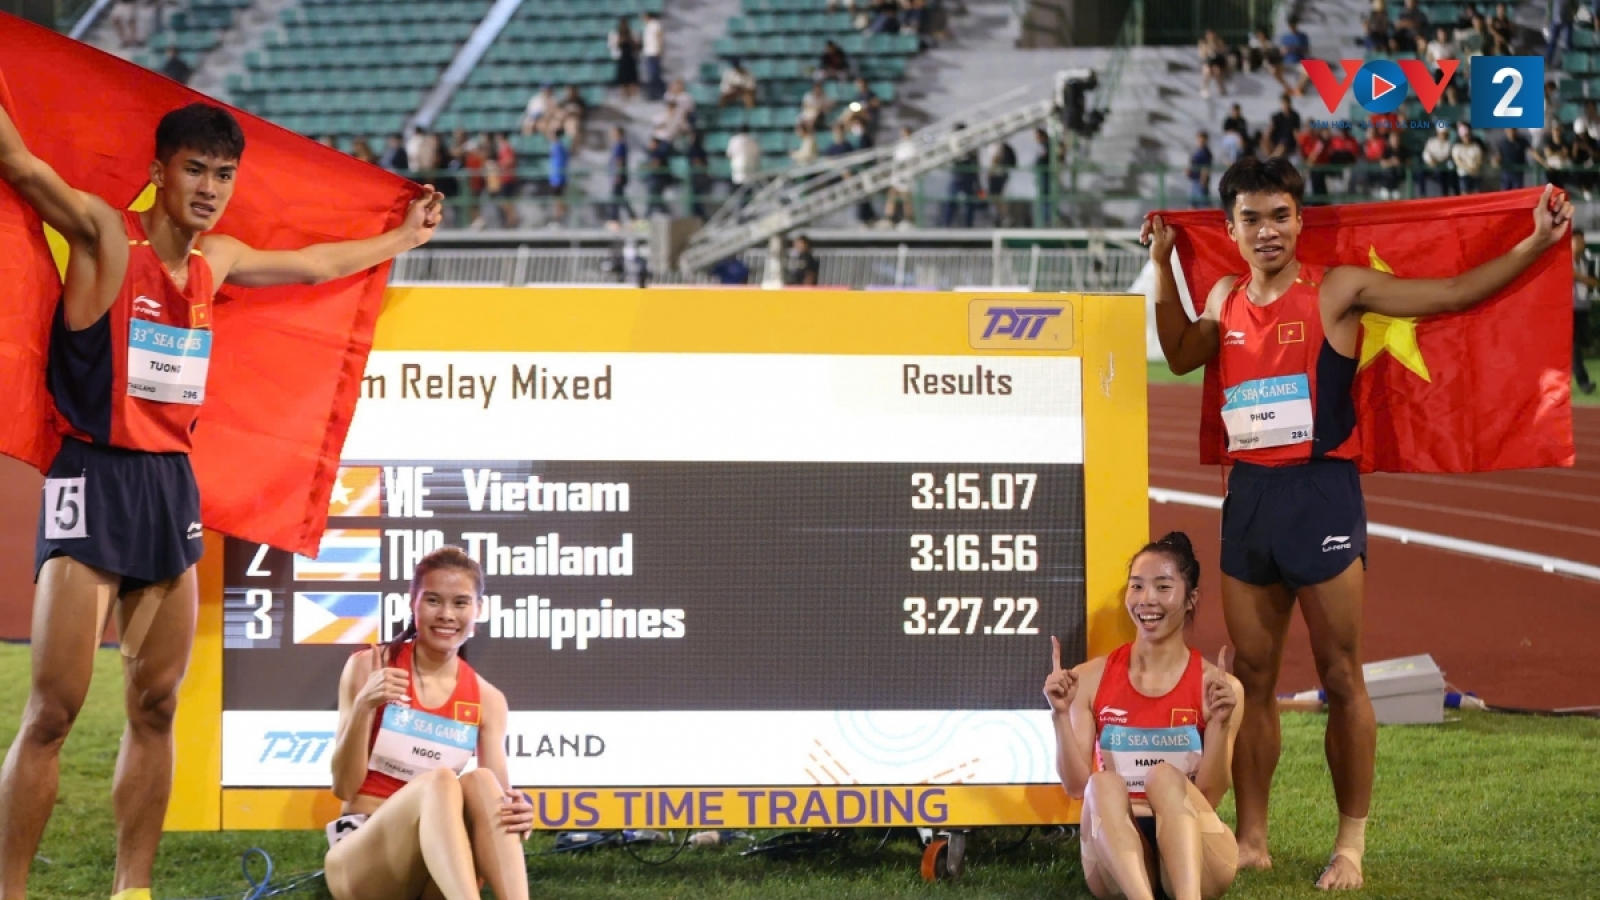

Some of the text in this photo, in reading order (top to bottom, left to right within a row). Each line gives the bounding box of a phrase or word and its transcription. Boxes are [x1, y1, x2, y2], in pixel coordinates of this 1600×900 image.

[152, 332, 174, 349] SEA
[150, 360, 182, 374] TUONG
[903, 363, 1013, 396] Results
[182, 390, 198, 400] 296
[401, 363, 497, 409] Relay
[512, 363, 612, 400] Mixed
[1262, 382, 1299, 398] GAMES
[1250, 411, 1276, 422] PHUC
[384, 466, 1038, 518] VIE Vietnam 3:15.07
[54, 486, 80, 531] 5
[461, 532, 633, 576] Thailand
[910, 534, 1038, 572] 3:16.56
[245, 588, 273, 640] 3
[468, 595, 686, 650] Philippines
[903, 596, 1040, 635] 3:27.22
[413, 718, 433, 734] SEA
[435, 724, 469, 744] GAMES
[1128, 735, 1149, 746] SEA
[1151, 734, 1190, 746] GAMES
[412, 746, 442, 760] NGOC
[505, 734, 606, 758] ILAND
[523, 788, 949, 828] US TIME TRADING
